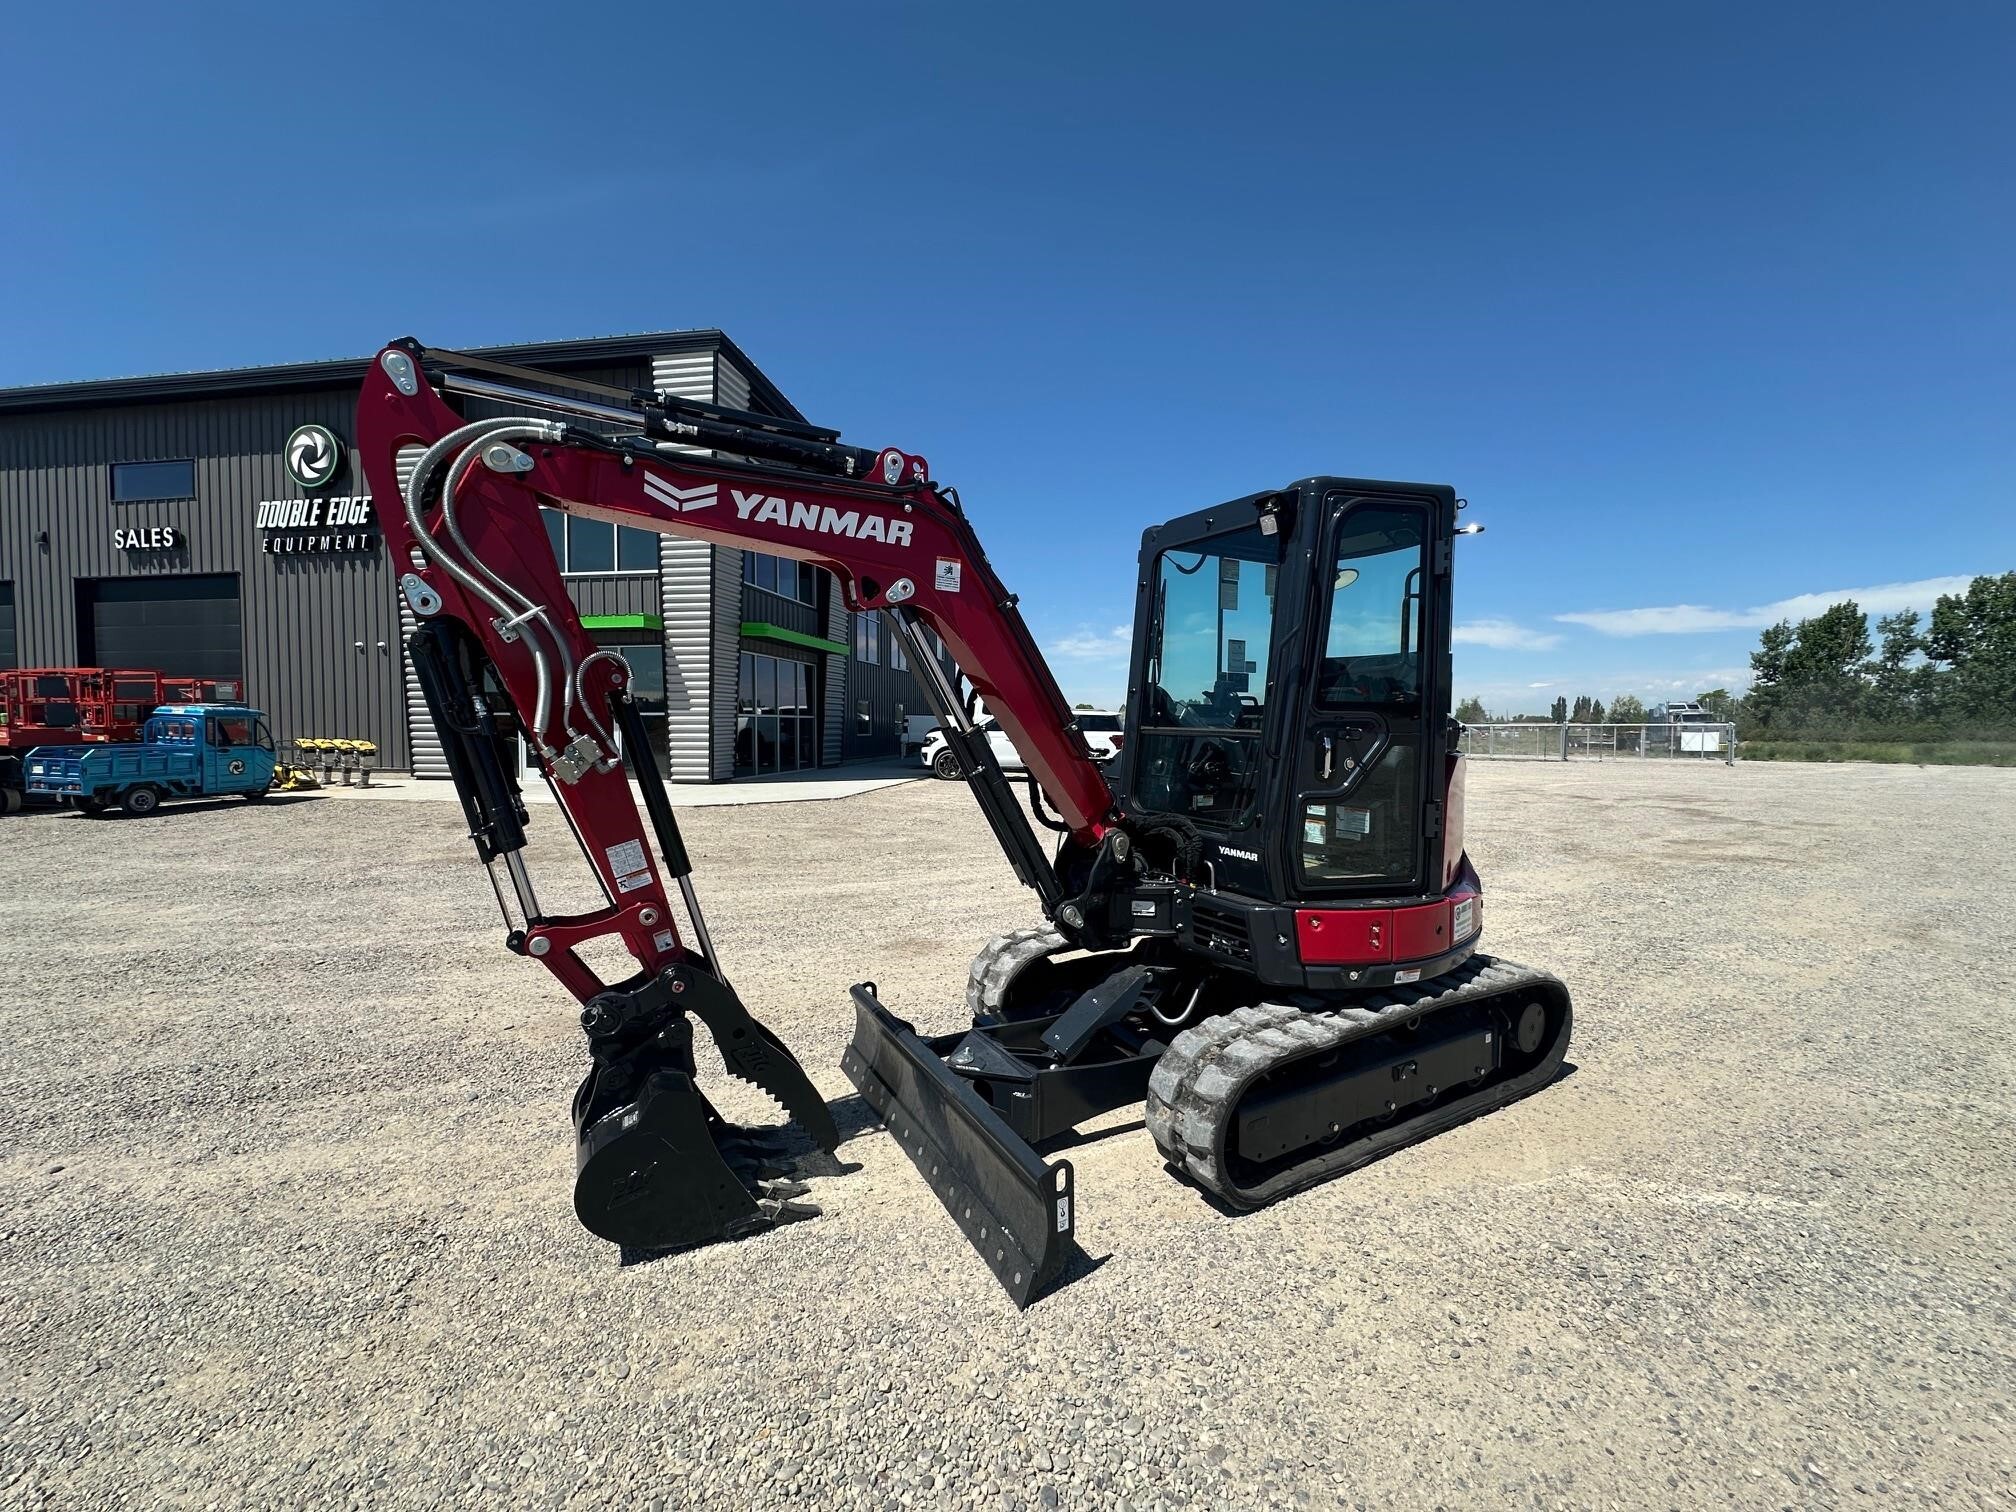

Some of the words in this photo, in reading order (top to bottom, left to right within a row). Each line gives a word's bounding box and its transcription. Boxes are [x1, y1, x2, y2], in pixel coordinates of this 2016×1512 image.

[256, 498, 322, 529] DOUBLE
[326, 495, 373, 526] EDGE
[730, 489, 914, 547] YANMAR
[114, 527, 174, 549] SALES
[262, 534, 368, 553] EQUIPMENT
[1218, 845, 1258, 862] YANMAR
